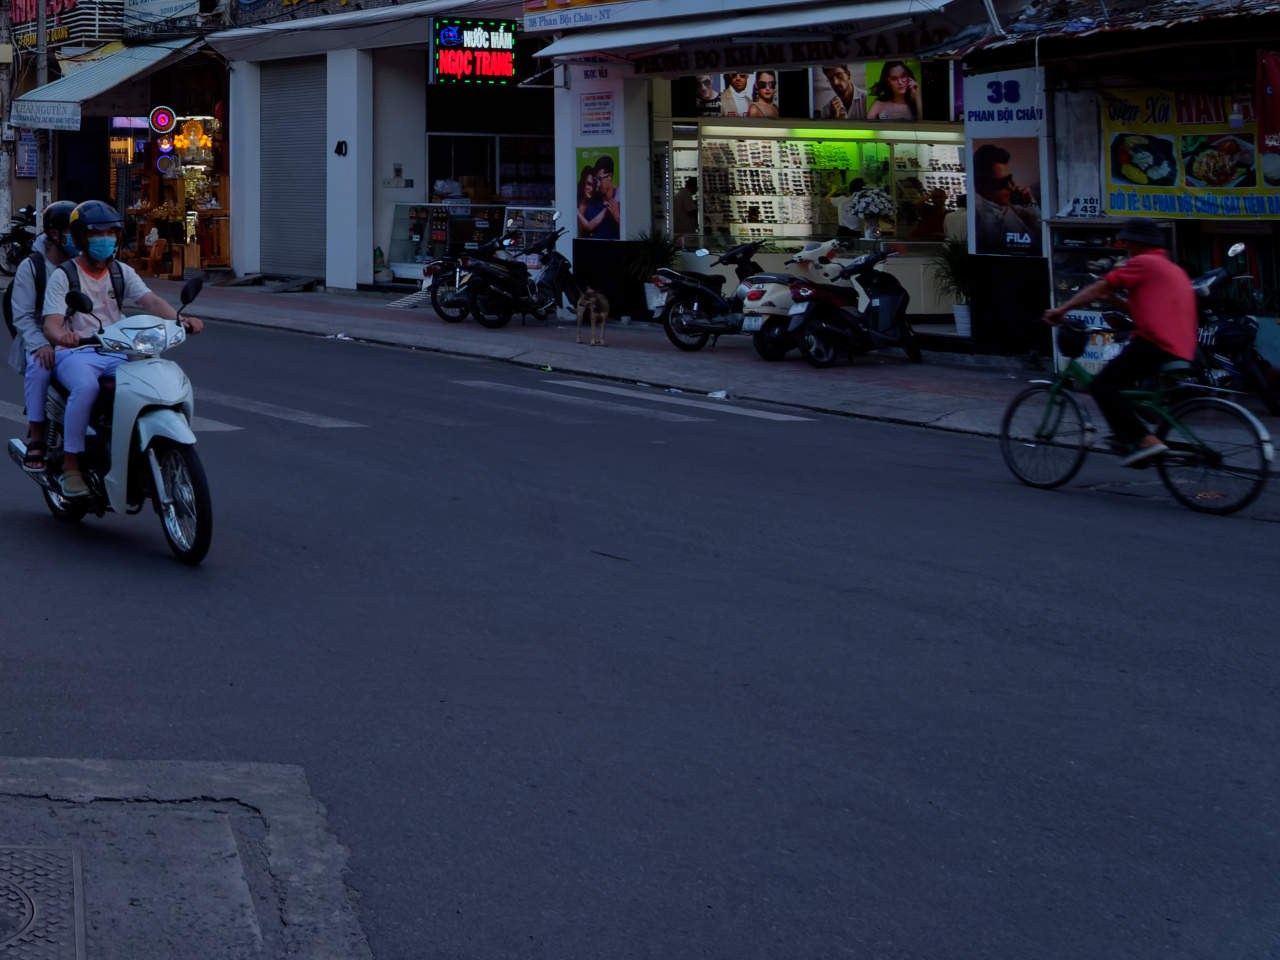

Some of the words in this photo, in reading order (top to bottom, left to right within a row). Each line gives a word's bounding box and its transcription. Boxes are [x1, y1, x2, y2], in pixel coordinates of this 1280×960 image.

[463, 26, 489, 48] NƯỚC
[438, 49, 472, 79] NGỌC
[474, 50, 513, 77] TRANG
[987, 80, 1020, 103] 38
[968, 110, 994, 121] PHAN
[997, 107, 1013, 123] BỘI
[1004, 232, 1032, 244] FILA
